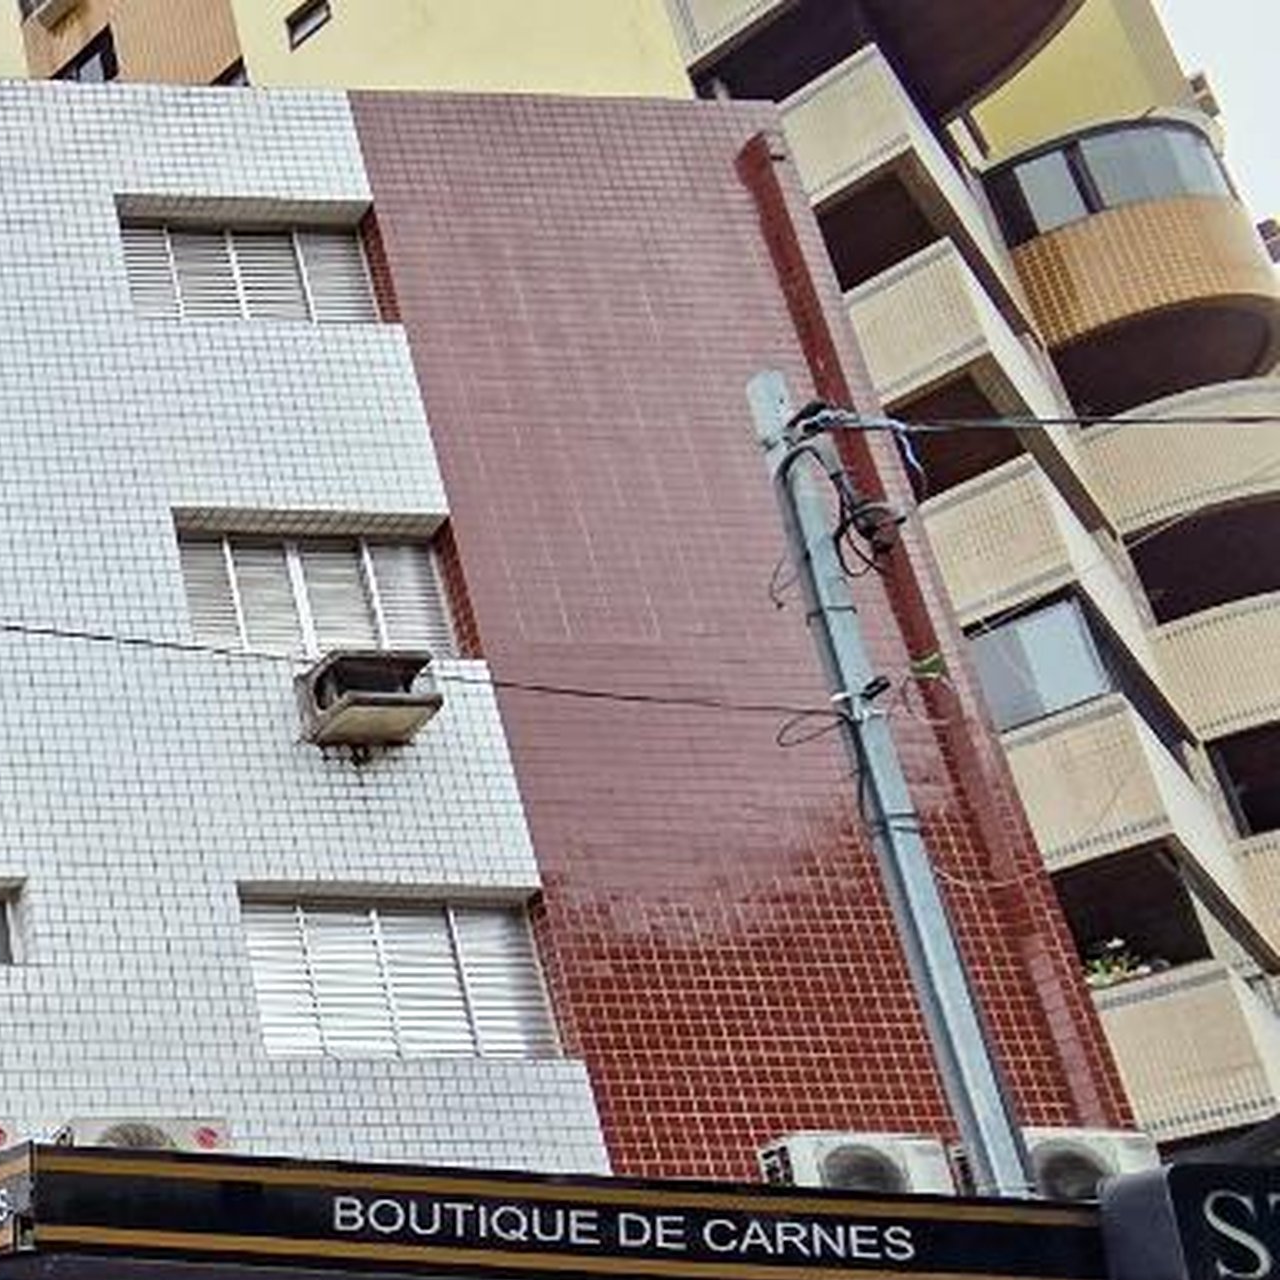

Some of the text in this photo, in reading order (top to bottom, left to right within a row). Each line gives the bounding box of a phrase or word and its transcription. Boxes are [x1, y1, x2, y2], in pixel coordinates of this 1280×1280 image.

[333, 1196, 916, 1263] BOUTIQUE DE CARNES
